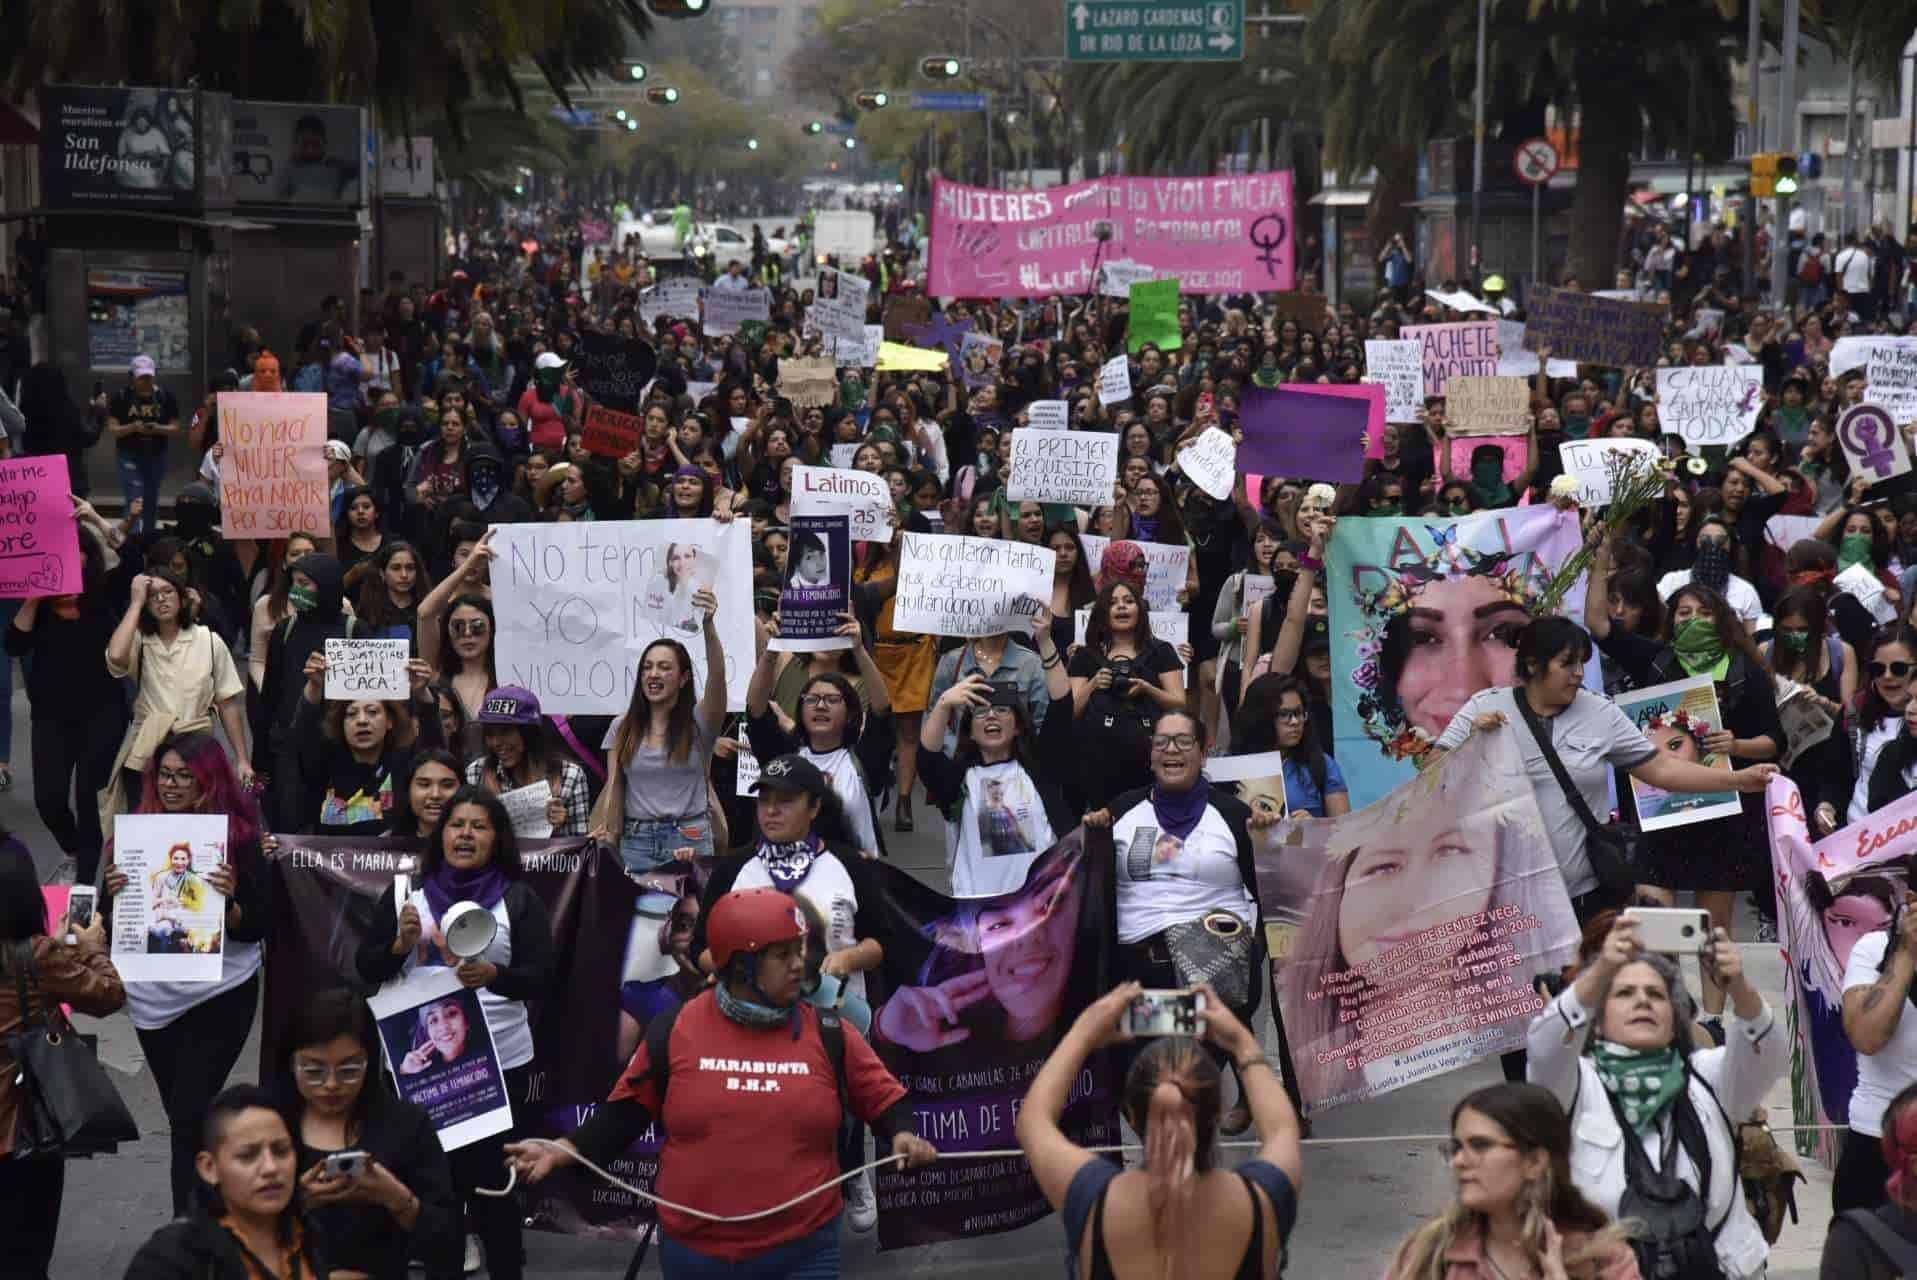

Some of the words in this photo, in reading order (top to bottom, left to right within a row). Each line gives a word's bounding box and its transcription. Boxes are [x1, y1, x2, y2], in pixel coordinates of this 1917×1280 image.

[1093, 8, 1138, 27] LAZARO
[1144, 7, 1203, 26] CARDENAS
[1128, 33, 1143, 51] DE
[1150, 33, 1166, 51] LA
[1170, 33, 1203, 51] LOZA
[64, 132, 99, 150] San
[64, 152, 151, 175] Ildefonso
[939, 186, 1053, 223] MUJERES
[1154, 179, 1286, 213] VIOLENCIA
[1403, 327, 1496, 359] ACHETE
[1667, 368, 1746, 390] CALLAN
[1666, 414, 1747, 440] TODAS
[1038, 437, 1111, 460] PRIMER
[233, 447, 300, 484] MUJER
[1013, 456, 1106, 481] REQUISITO
[803, 471, 881, 497] Latimos
[511, 536, 565, 587] No
[904, 535, 933, 562] Nos
[939, 536, 1000, 572] quitaron
[529, 593, 599, 645] YO
[328, 650, 344, 661] DE
[487, 699, 516, 715] OBEY
[291, 851, 324, 868] ELLA
[331, 853, 345, 870] ES
[524, 855, 580, 873] ZAMUDIO
[1487, 904, 1521, 922] VEGA
[1372, 1029, 1386, 1043] de
[1391, 1034, 1424, 1052] unido
[1471, 997, 1544, 1027] FEMINICIDIO
[699, 1057, 810, 1075] MARABUNTA
[949, 1067, 1005, 1090] CABANILLAS
[912, 1108, 969, 1143] CTIMA
[979, 1103, 1001, 1135] DE
[920, 1172, 946, 1186] COMO
